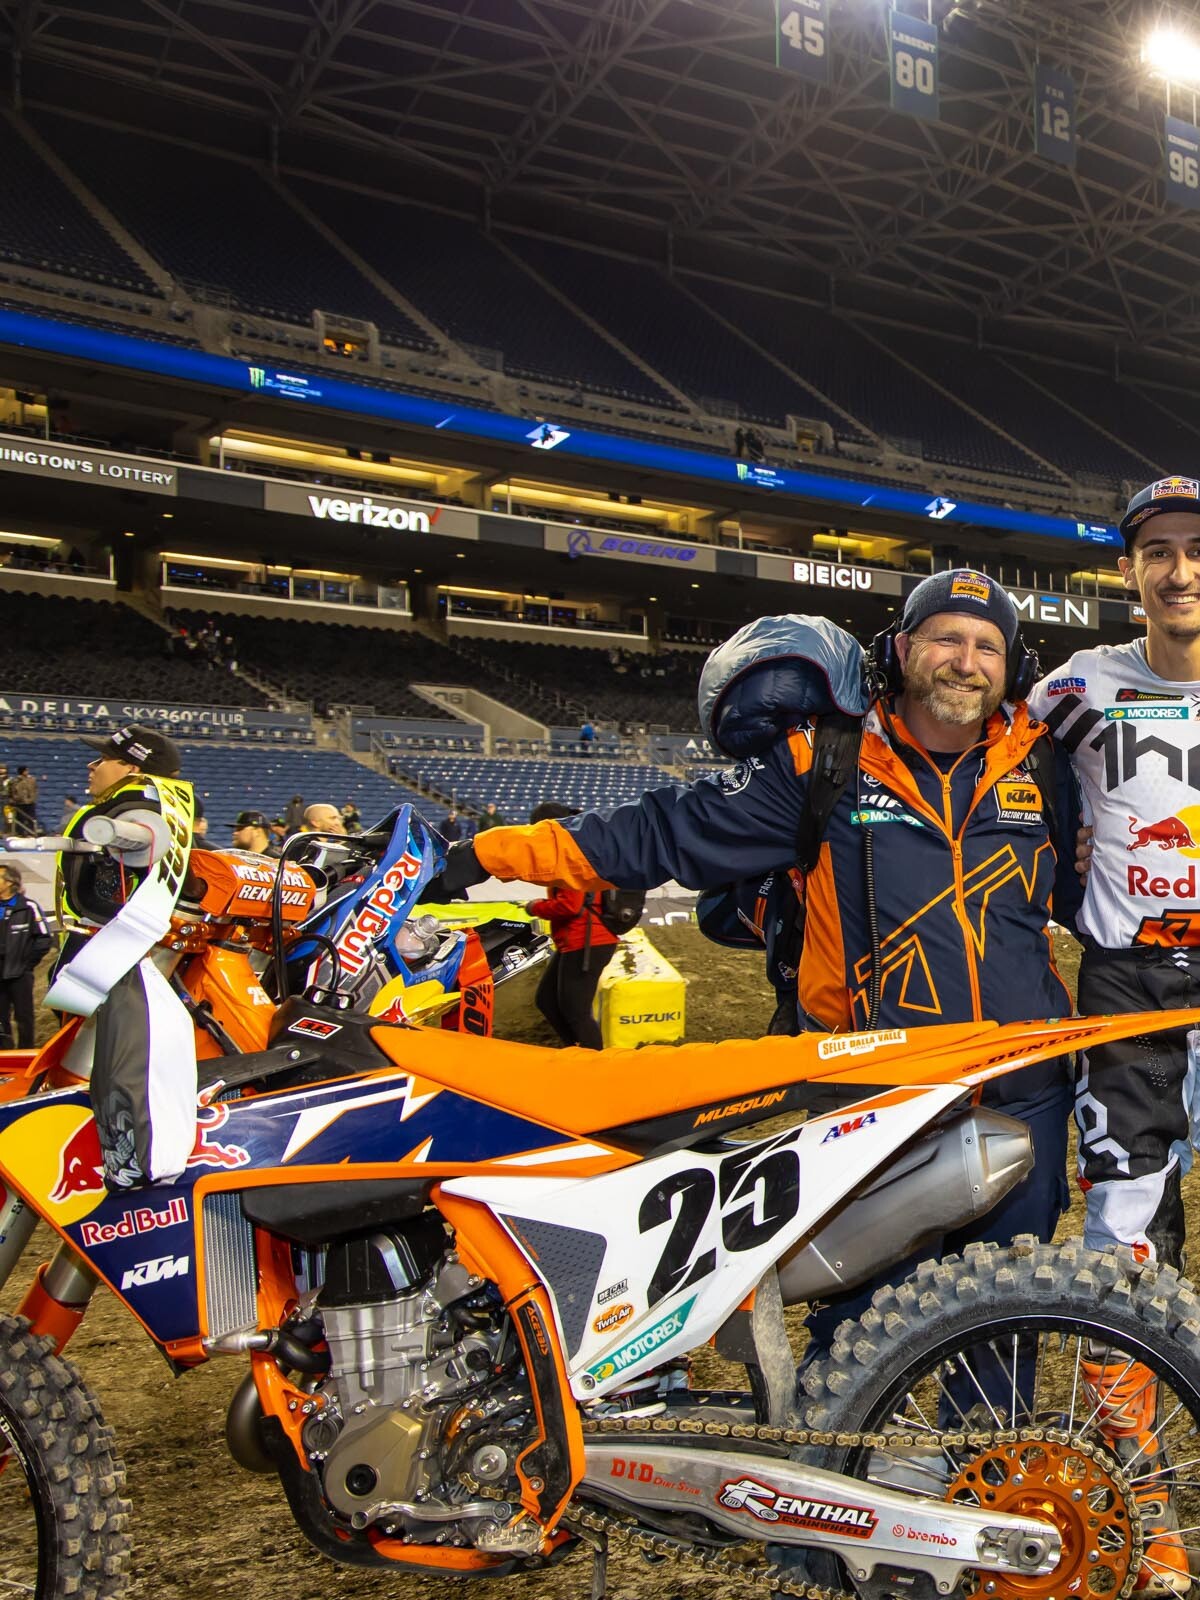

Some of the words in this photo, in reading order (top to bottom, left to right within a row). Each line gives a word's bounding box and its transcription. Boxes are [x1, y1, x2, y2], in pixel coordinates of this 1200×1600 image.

[781, 11, 825, 57] 45
[895, 51, 934, 95] 80
[1041, 102, 1070, 142] 12
[1169, 151, 1198, 189] 96
[0, 448, 93, 473] INGTON'S
[99, 463, 174, 486] LOTTERY
[308, 495, 430, 533] verizon
[600, 536, 697, 562] BOEING
[1048, 677, 1087, 690] PARTS
[1048, 687, 1087, 697] UNLIMITED
[21, 699, 111, 719] DELTA
[1127, 708, 1183, 718] MOTOREX
[1006, 789, 1037, 804] KTM
[1000, 811, 1024, 820] FACTORY
[1024, 812, 1042, 821] RACIN
[238, 884, 308, 906] RENHAL
[369, 851, 422, 917] Red
[1127, 864, 1197, 899] Red
[336, 910, 389, 977] Bull
[619, 1011, 681, 1026] SUZUKI
[822, 1041, 846, 1056] SELLE
[849, 1036, 875, 1048] DALLA
[877, 1030, 902, 1042] VALLE
[985, 1027, 1102, 1066] DUNLOP
[693, 1089, 787, 1128] MUSQUIN
[820, 1112, 878, 1145] AMA
[80, 1210, 134, 1248] Red
[135, 1196, 189, 1233] Bull
[638, 1127, 804, 1310] 25
[121, 1255, 189, 1290] KTM
[595, 1313, 618, 1333] Twin
[618, 1303, 632, 1319] Air
[613, 1312, 683, 1369] MOTOREX
[610, 1457, 654, 1483] DID
[781, 1516, 869, 1537] CHAINWHEELS
[906, 1527, 958, 1548] brembo
